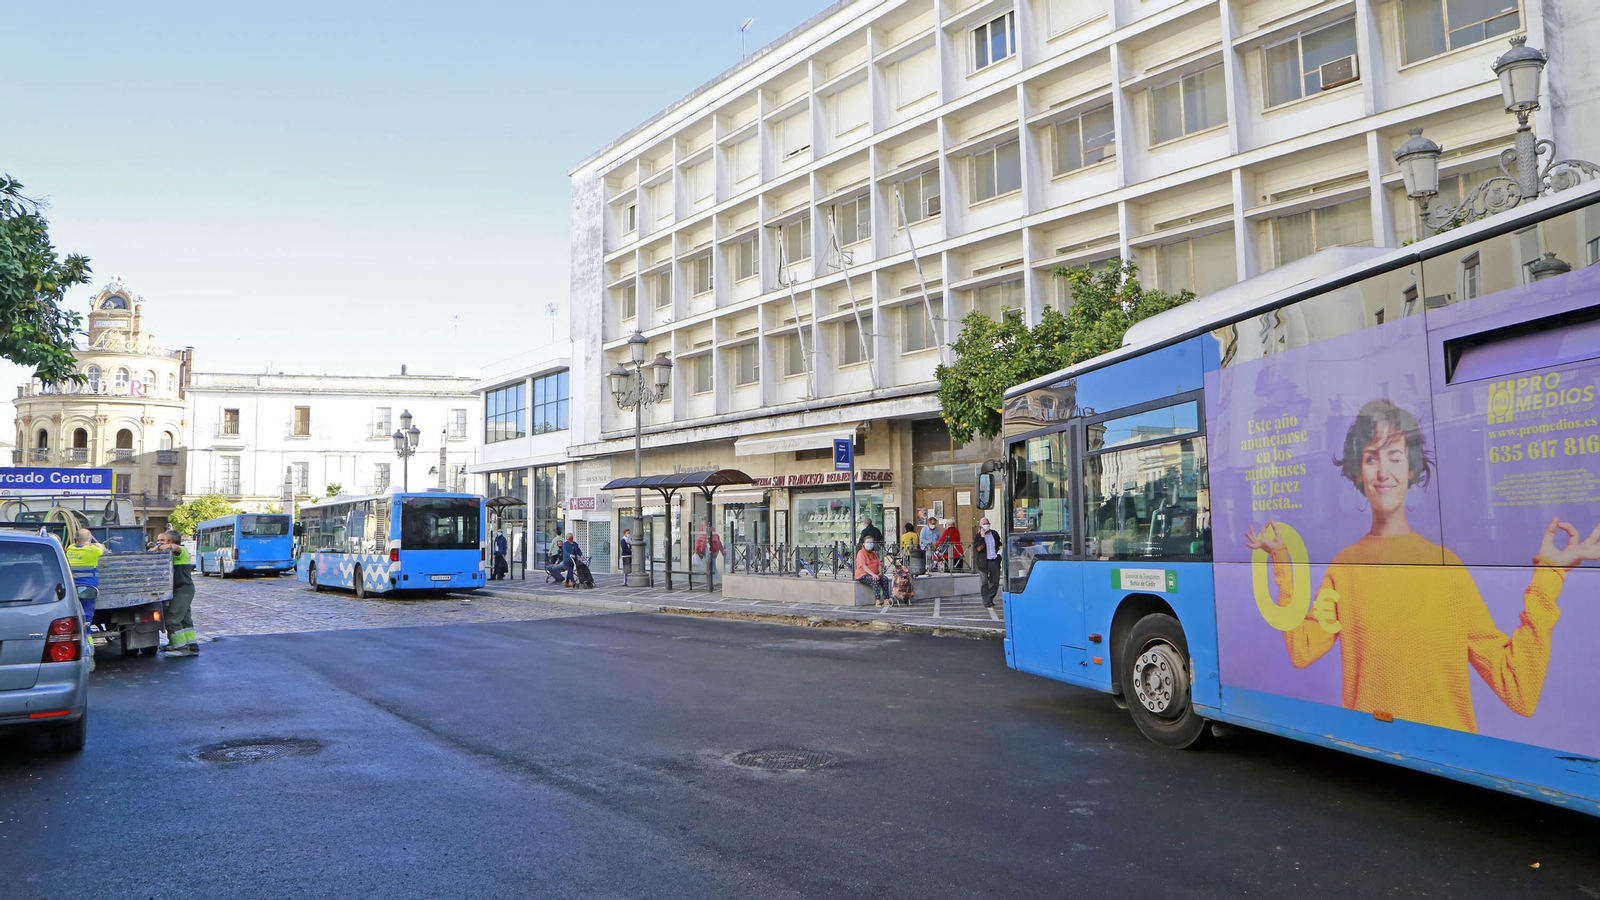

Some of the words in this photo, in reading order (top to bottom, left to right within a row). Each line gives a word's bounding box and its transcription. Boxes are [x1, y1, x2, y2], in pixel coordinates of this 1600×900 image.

[1517, 372, 1560, 395] PRO
[1516, 385, 1594, 413] MEDIOS
[1515, 409, 1559, 421] EUROPEAN
[1563, 403, 1594, 414] GROUP
[1247, 419, 1272, 435] Este
[1274, 413, 1298, 430] año
[1488, 418, 1598, 438] www.promedios.es
[1241, 429, 1308, 451] anunciarse
[1489, 444, 1523, 464] 635
[1528, 439, 1559, 460] 617
[1564, 434, 1600, 456] 816
[1256, 452, 1271, 464] en
[1273, 446, 1292, 462] los
[772, 475, 786, 487] SAN
[788, 473, 824, 486] FRANCISCO
[826, 472, 858, 483] RELOJERA
[862, 471, 894, 481] REGALOS
[1245, 463, 1307, 481] autobuses
[1252, 480, 1267, 496] de
[1269, 480, 1300, 498] Jerez
[579, 499, 594, 508] ESTEVE
[1252, 497, 1303, 511] cuesta...
